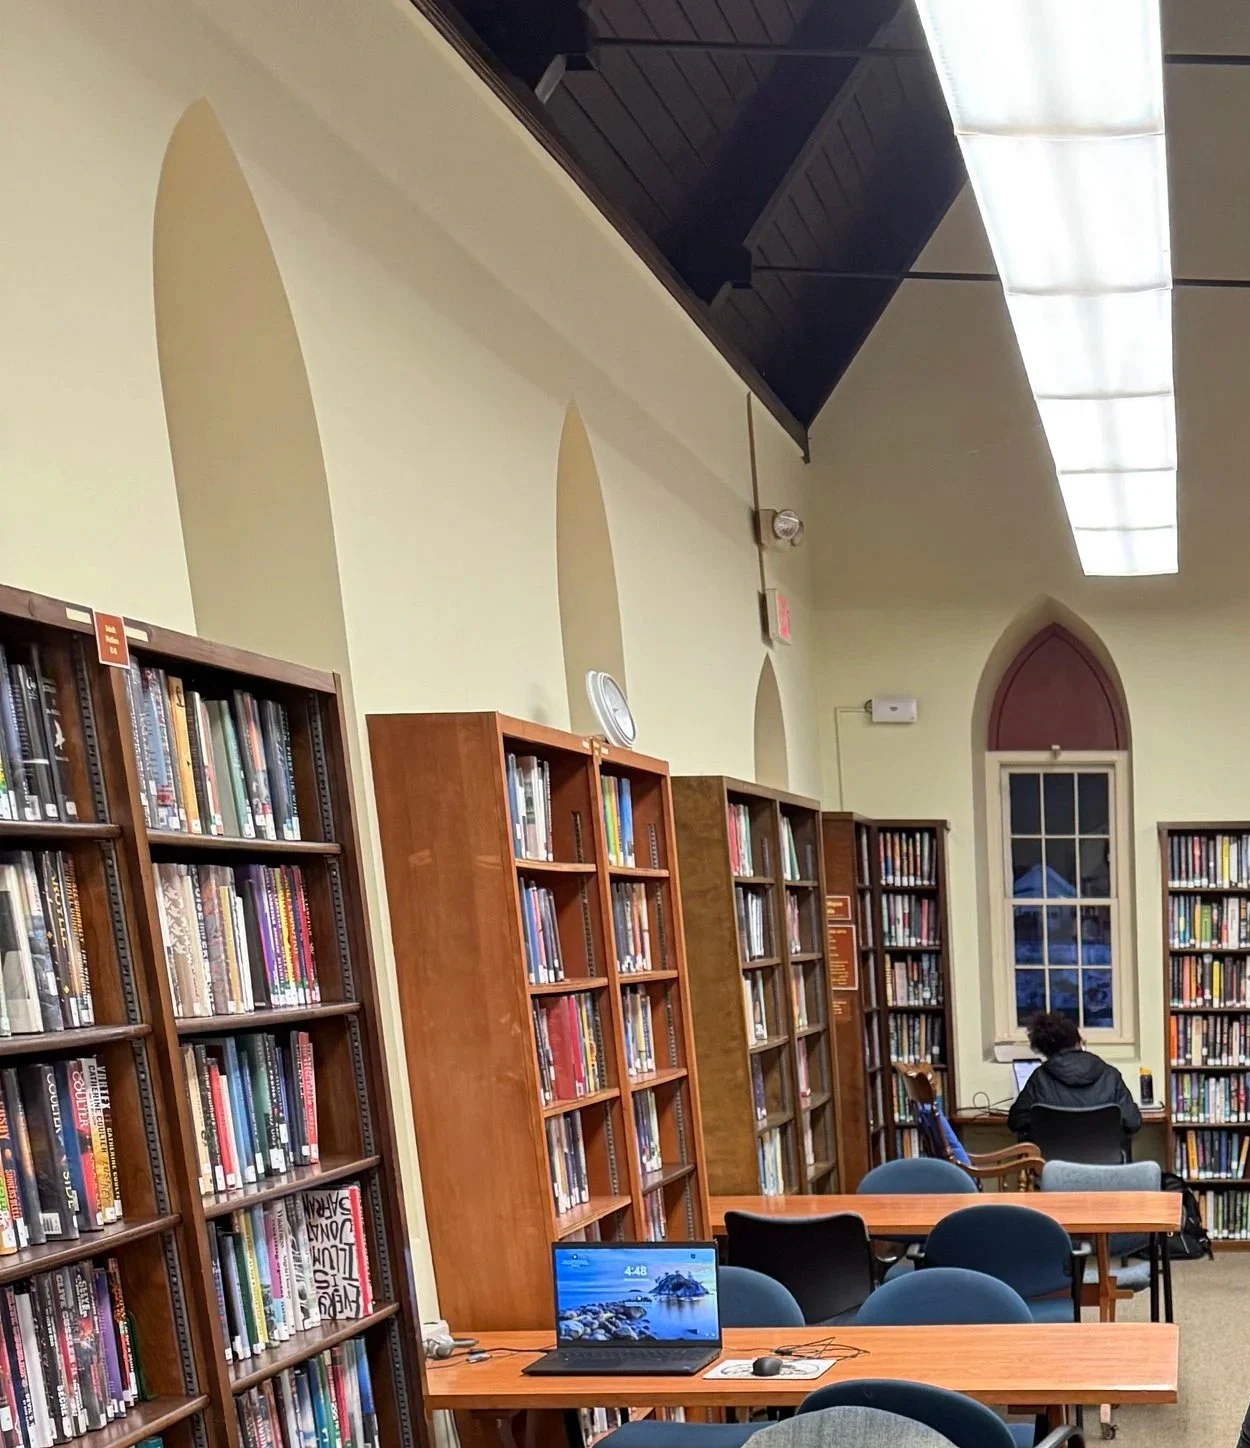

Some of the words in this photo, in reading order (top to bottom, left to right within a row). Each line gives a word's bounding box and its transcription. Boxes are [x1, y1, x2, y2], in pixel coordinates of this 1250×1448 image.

[71, 1070, 90, 1128] COULTER
[88, 1064, 102, 1113] CATHERINE
[96, 1115, 107, 1153] COULTER
[95, 1064, 111, 1110] VORTEX
[105, 1126, 118, 1170] CATHERINE
[301, 1191, 352, 1219] SAFRAN
[624, 1266, 648, 1277] 4:48
